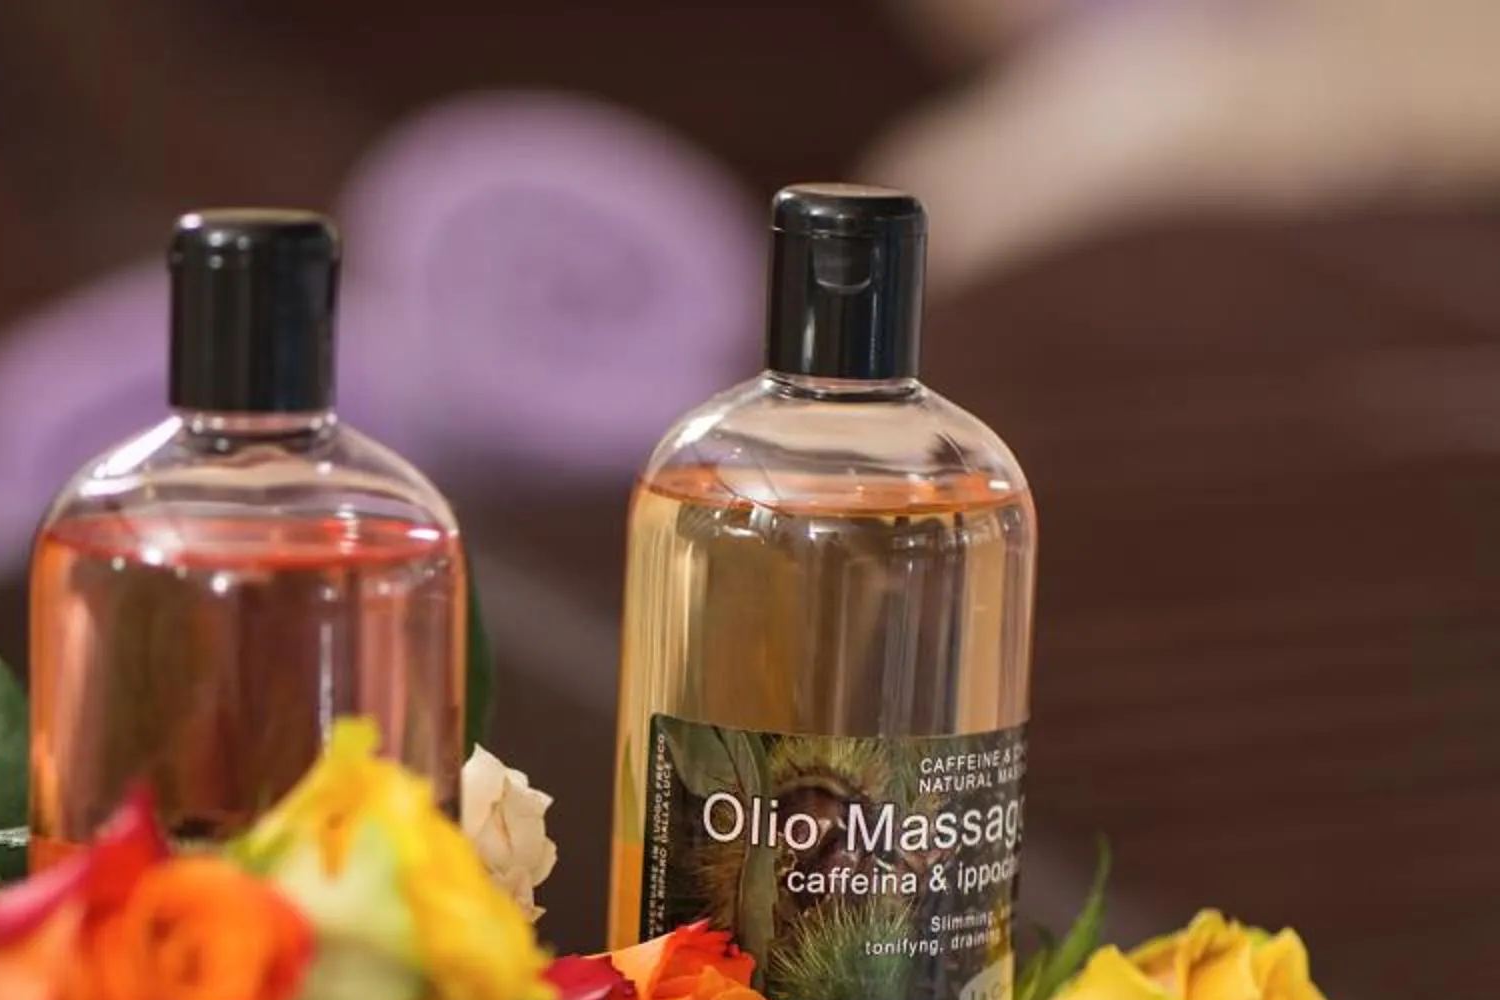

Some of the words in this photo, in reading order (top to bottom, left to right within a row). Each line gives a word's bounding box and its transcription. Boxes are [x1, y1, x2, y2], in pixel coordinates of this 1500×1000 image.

[920, 749, 1000, 775] CAFFEINE
[919, 770, 993, 794] NATURAL
[703, 792, 819, 851] Olio
[787, 866, 917, 896] caffeina
[929, 863, 948, 893] &
